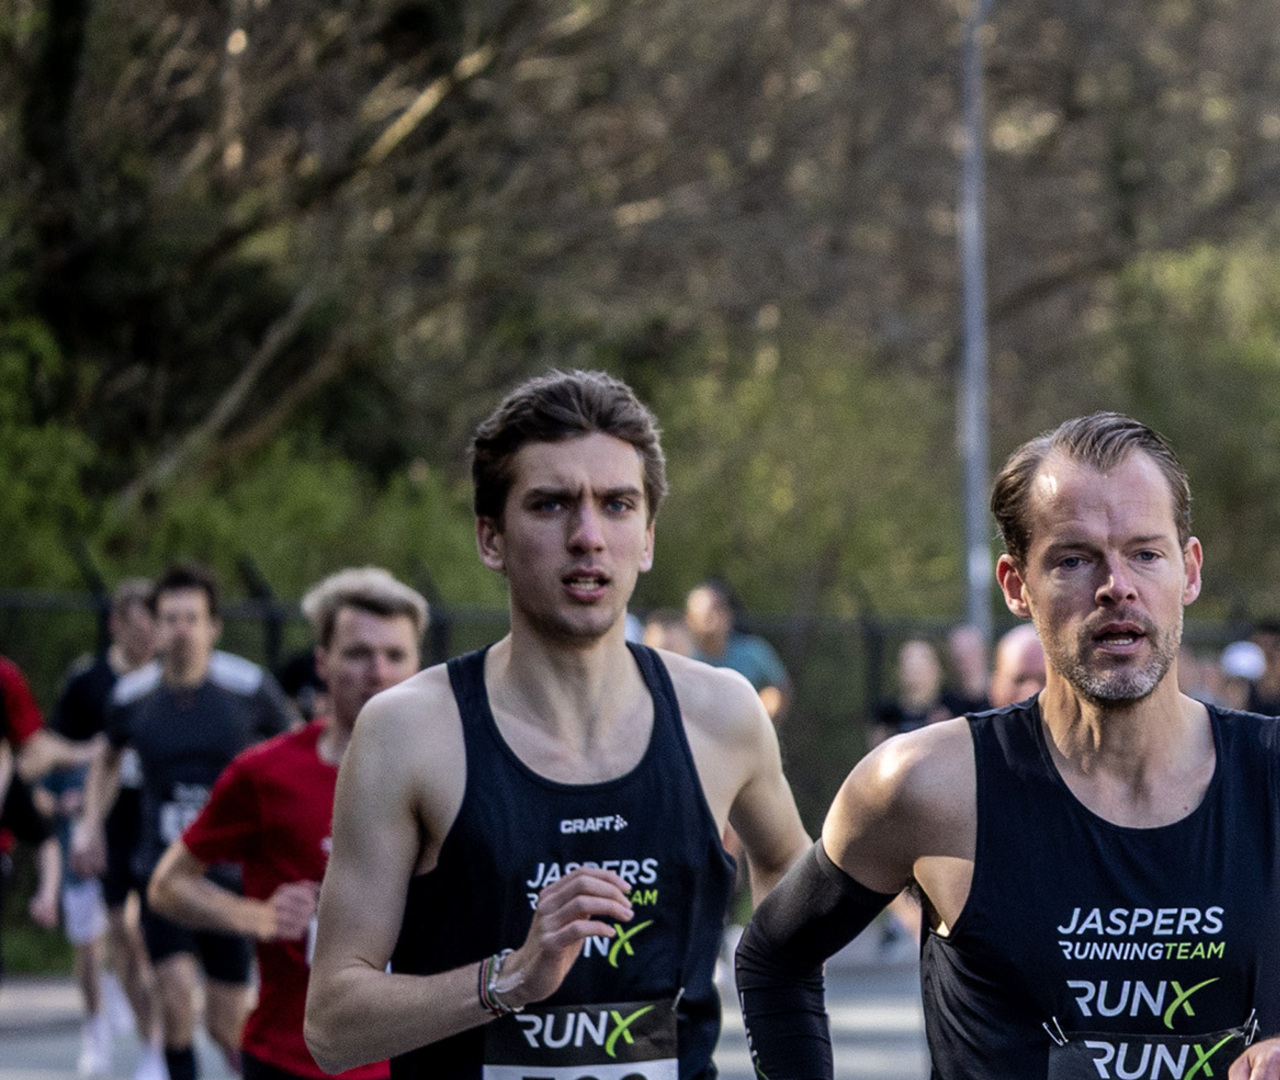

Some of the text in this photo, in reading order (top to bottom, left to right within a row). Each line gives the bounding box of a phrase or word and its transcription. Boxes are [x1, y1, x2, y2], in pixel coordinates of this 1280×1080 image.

[560, 815, 615, 834] CRAFT
[1056, 906, 1225, 936] JASPERS
[1057, 940, 1226, 961] RUNNINGTEAM
[1066, 976, 1220, 1030] RUNX
[515, 1004, 654, 1058] RUNX
